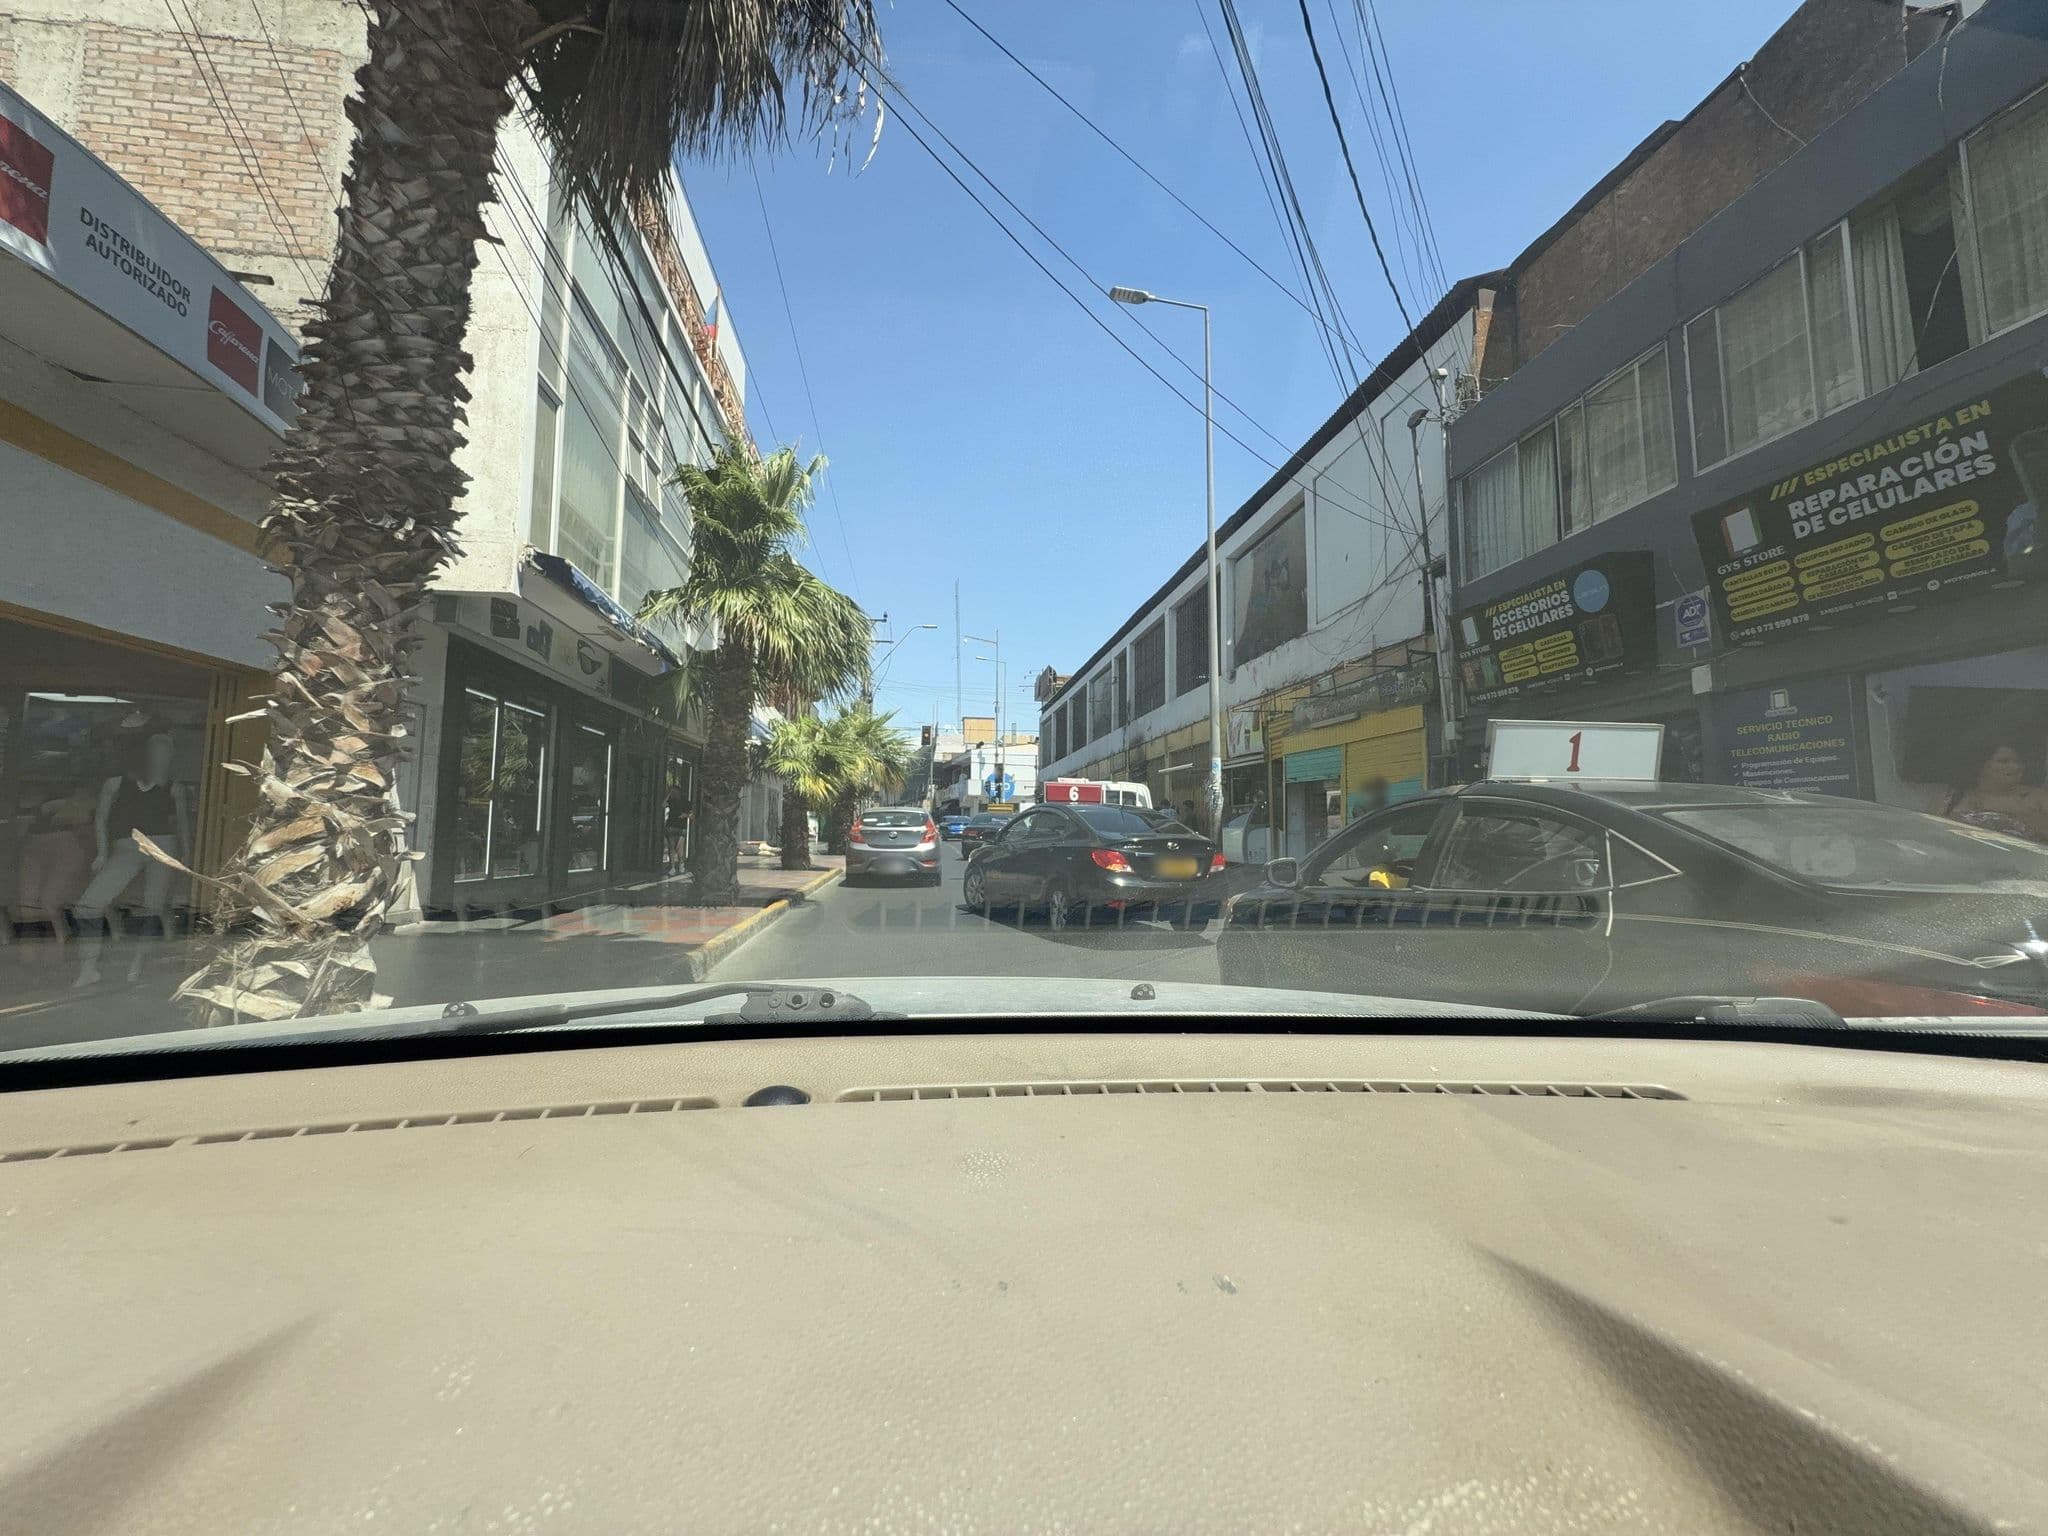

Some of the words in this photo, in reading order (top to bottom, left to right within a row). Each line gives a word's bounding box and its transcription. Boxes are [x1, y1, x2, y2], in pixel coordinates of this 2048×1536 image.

[81, 206, 191, 304] DISTRIBUIDOR
[85, 235, 187, 317] AUTORIZADO
[1804, 416, 1953, 486] ESPECIALISTA
[1955, 399, 1992, 425] EN
[1787, 430, 1990, 520] REPARACIÓN
[1792, 514, 1827, 540] DE
[1828, 453, 1997, 526] CELULARES
[1717, 560, 1741, 575] GYS
[1743, 545, 1786, 567] STORE
[1492, 590, 1570, 628] ACCESORIOS
[1498, 584, 1553, 612] ESPECIALISTA
[1553, 579, 1567, 591] EN
[1682, 604, 1701, 619] ADT
[1492, 626, 1508, 641] DE
[1508, 603, 1574, 636] CELULARES
[1736, 721, 1783, 735] SERVICIO
[1786, 715, 1833, 728] TECNICO
[1767, 730, 1801, 743] RADIO
[1566, 731, 1582, 772] 1
[1730, 738, 1846, 757] TELECOMUNICACIONES
[1068, 786, 1080, 801] 6
